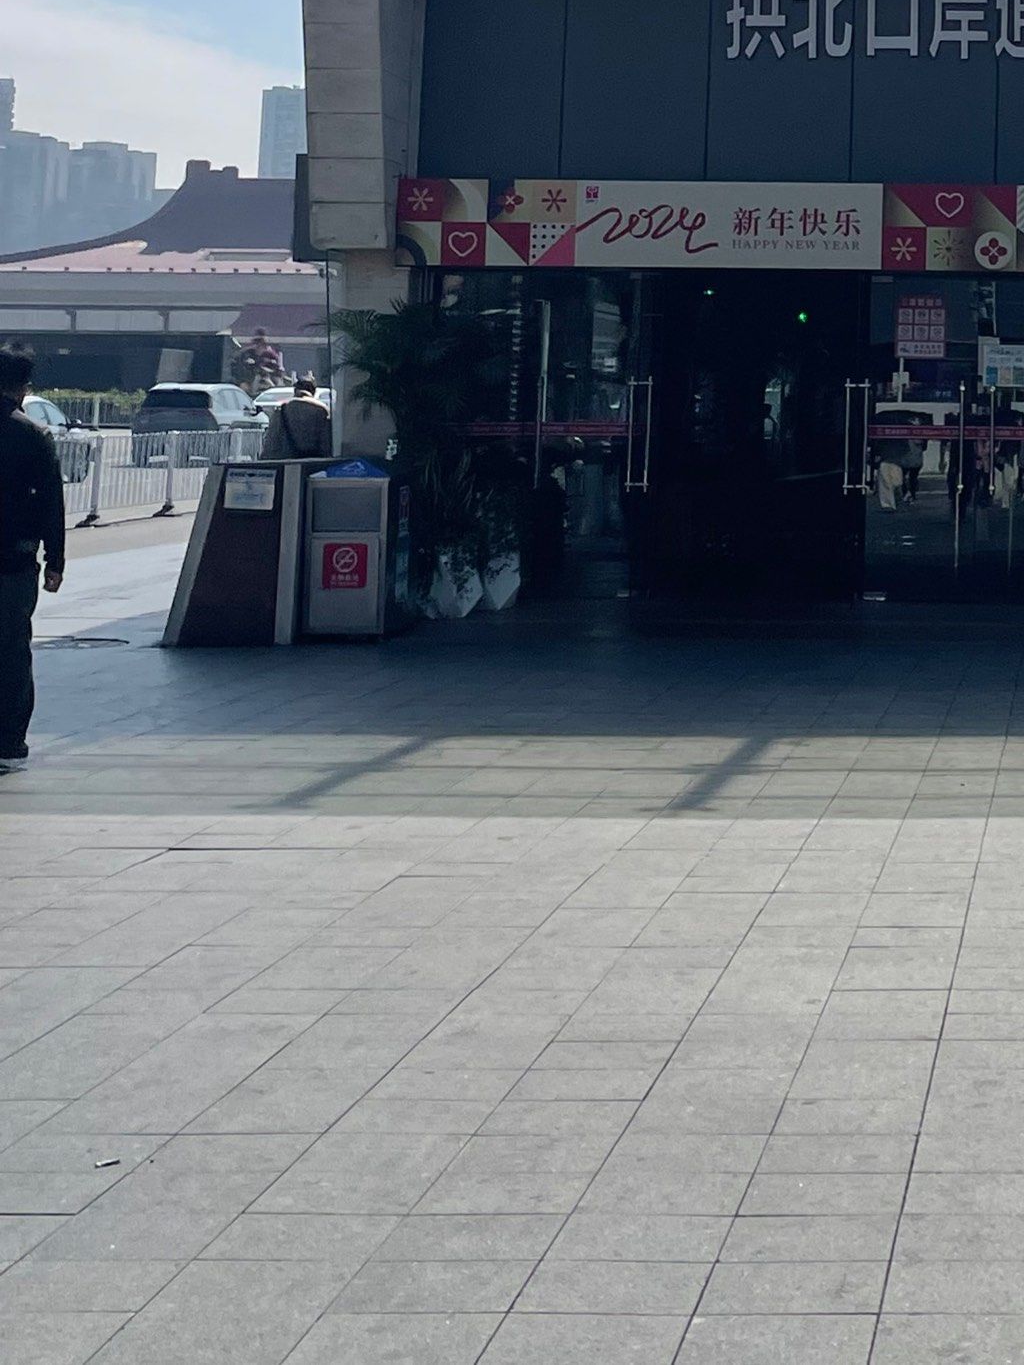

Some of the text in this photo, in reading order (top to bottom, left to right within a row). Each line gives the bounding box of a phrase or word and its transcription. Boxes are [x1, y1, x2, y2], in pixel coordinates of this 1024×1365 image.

[732, 206, 861, 237] 新年快乐
[732, 239, 861, 251] HAPPY NEW YEAR
